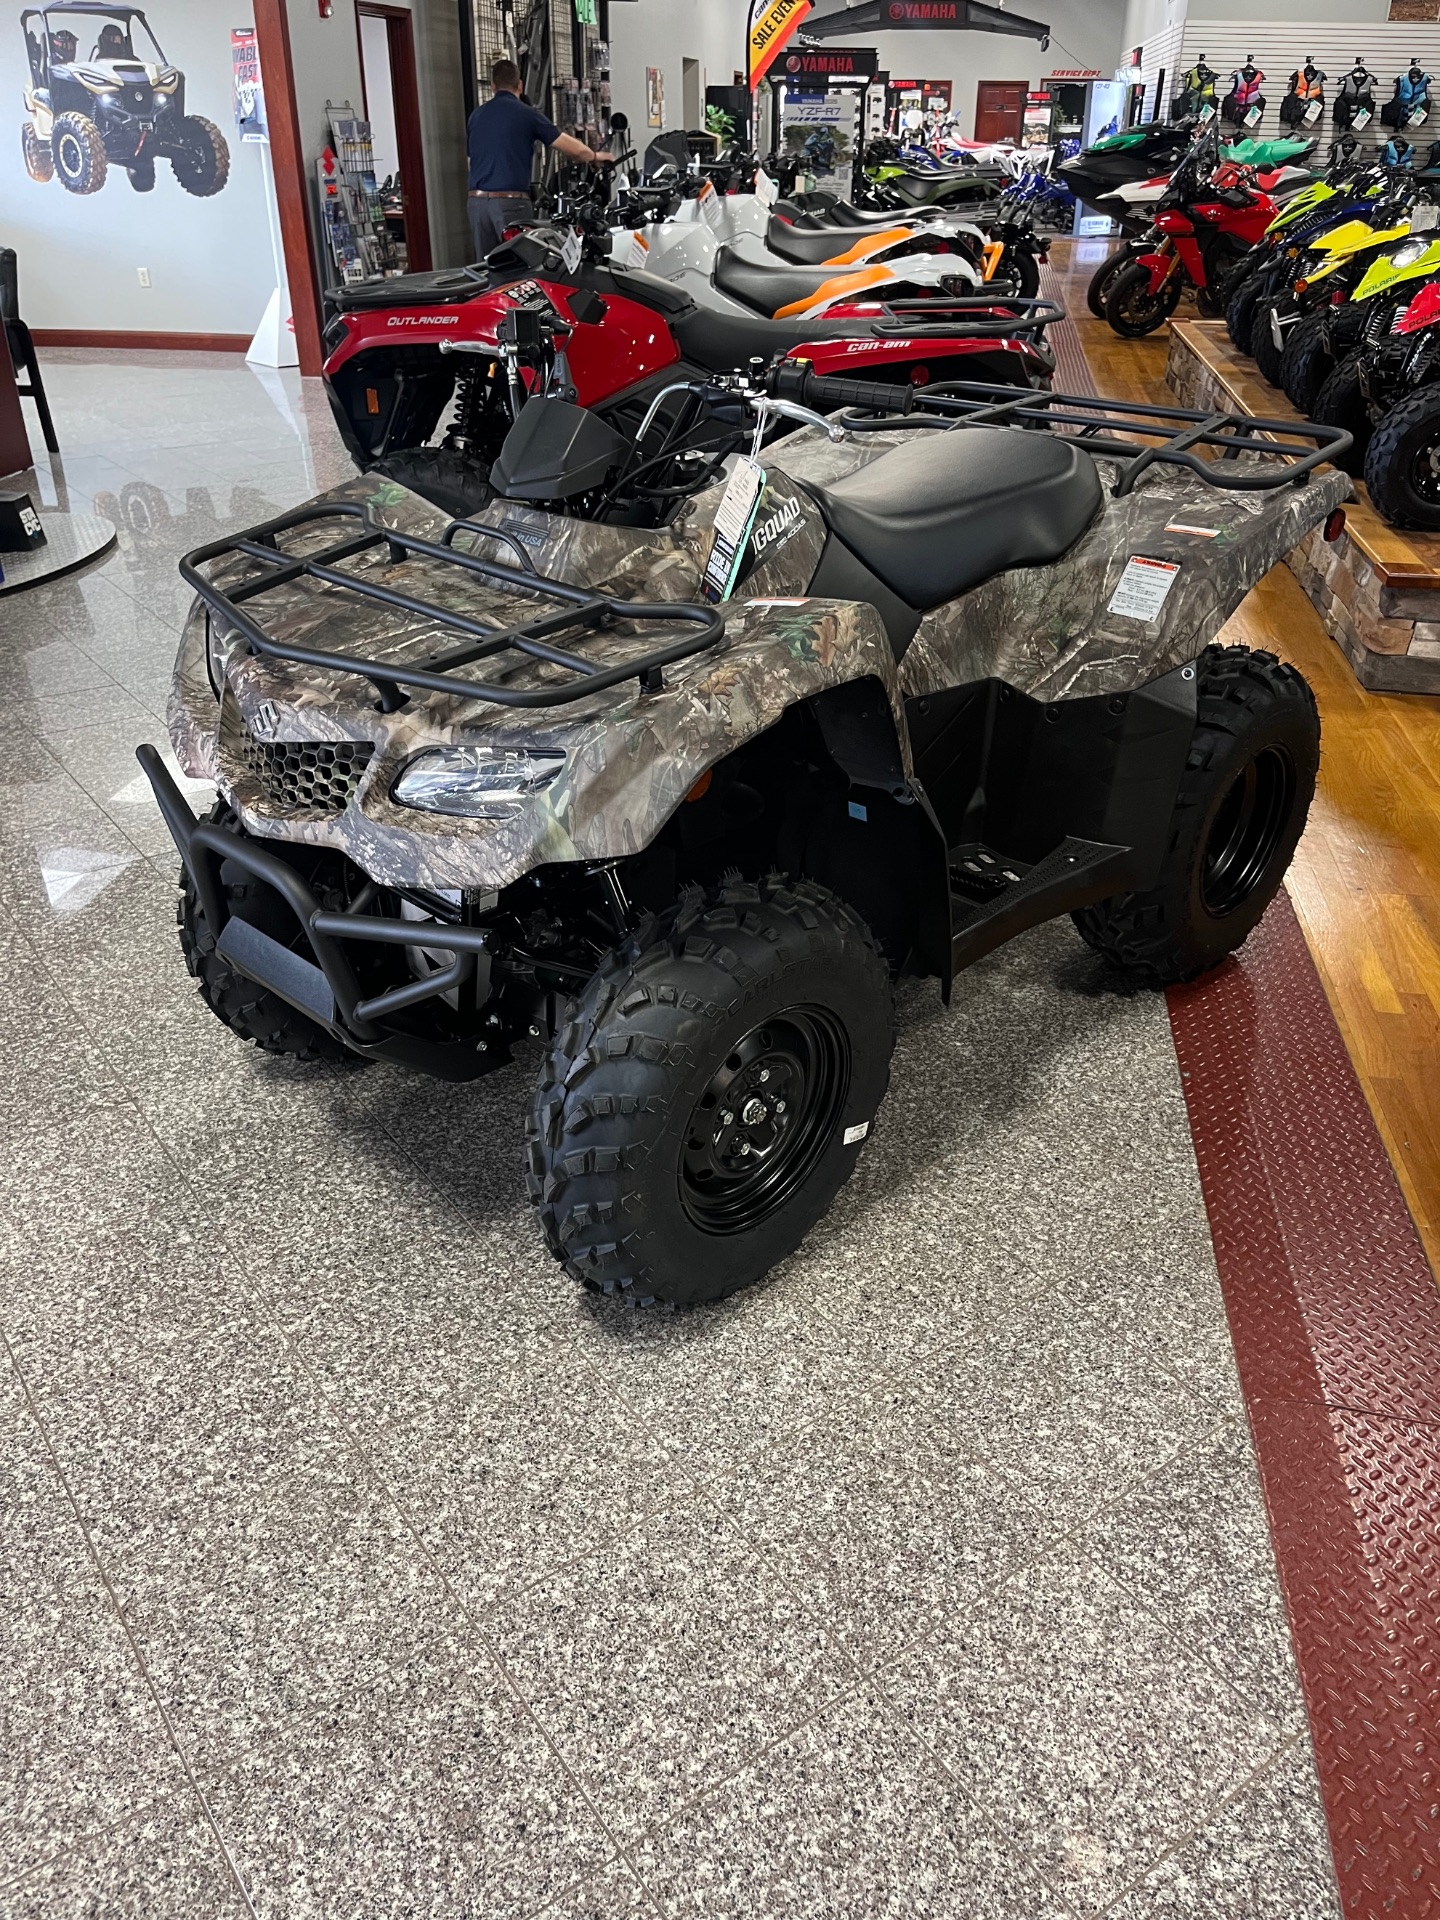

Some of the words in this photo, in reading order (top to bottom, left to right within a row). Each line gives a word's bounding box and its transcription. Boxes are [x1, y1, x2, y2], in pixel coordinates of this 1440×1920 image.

[905, 3, 957, 19] YAMAHA
[752, 20, 777, 50] SALE
[770, 0, 799, 25] EVEN
[232, 45, 257, 63] YABL
[801, 57, 854, 72] YAMAHA
[798, 107, 841, 116] YZF-R7
[387, 316, 459, 326] OUTLANDER
[847, 340, 912, 353] can-am
[525, 535, 542, 547] USA
